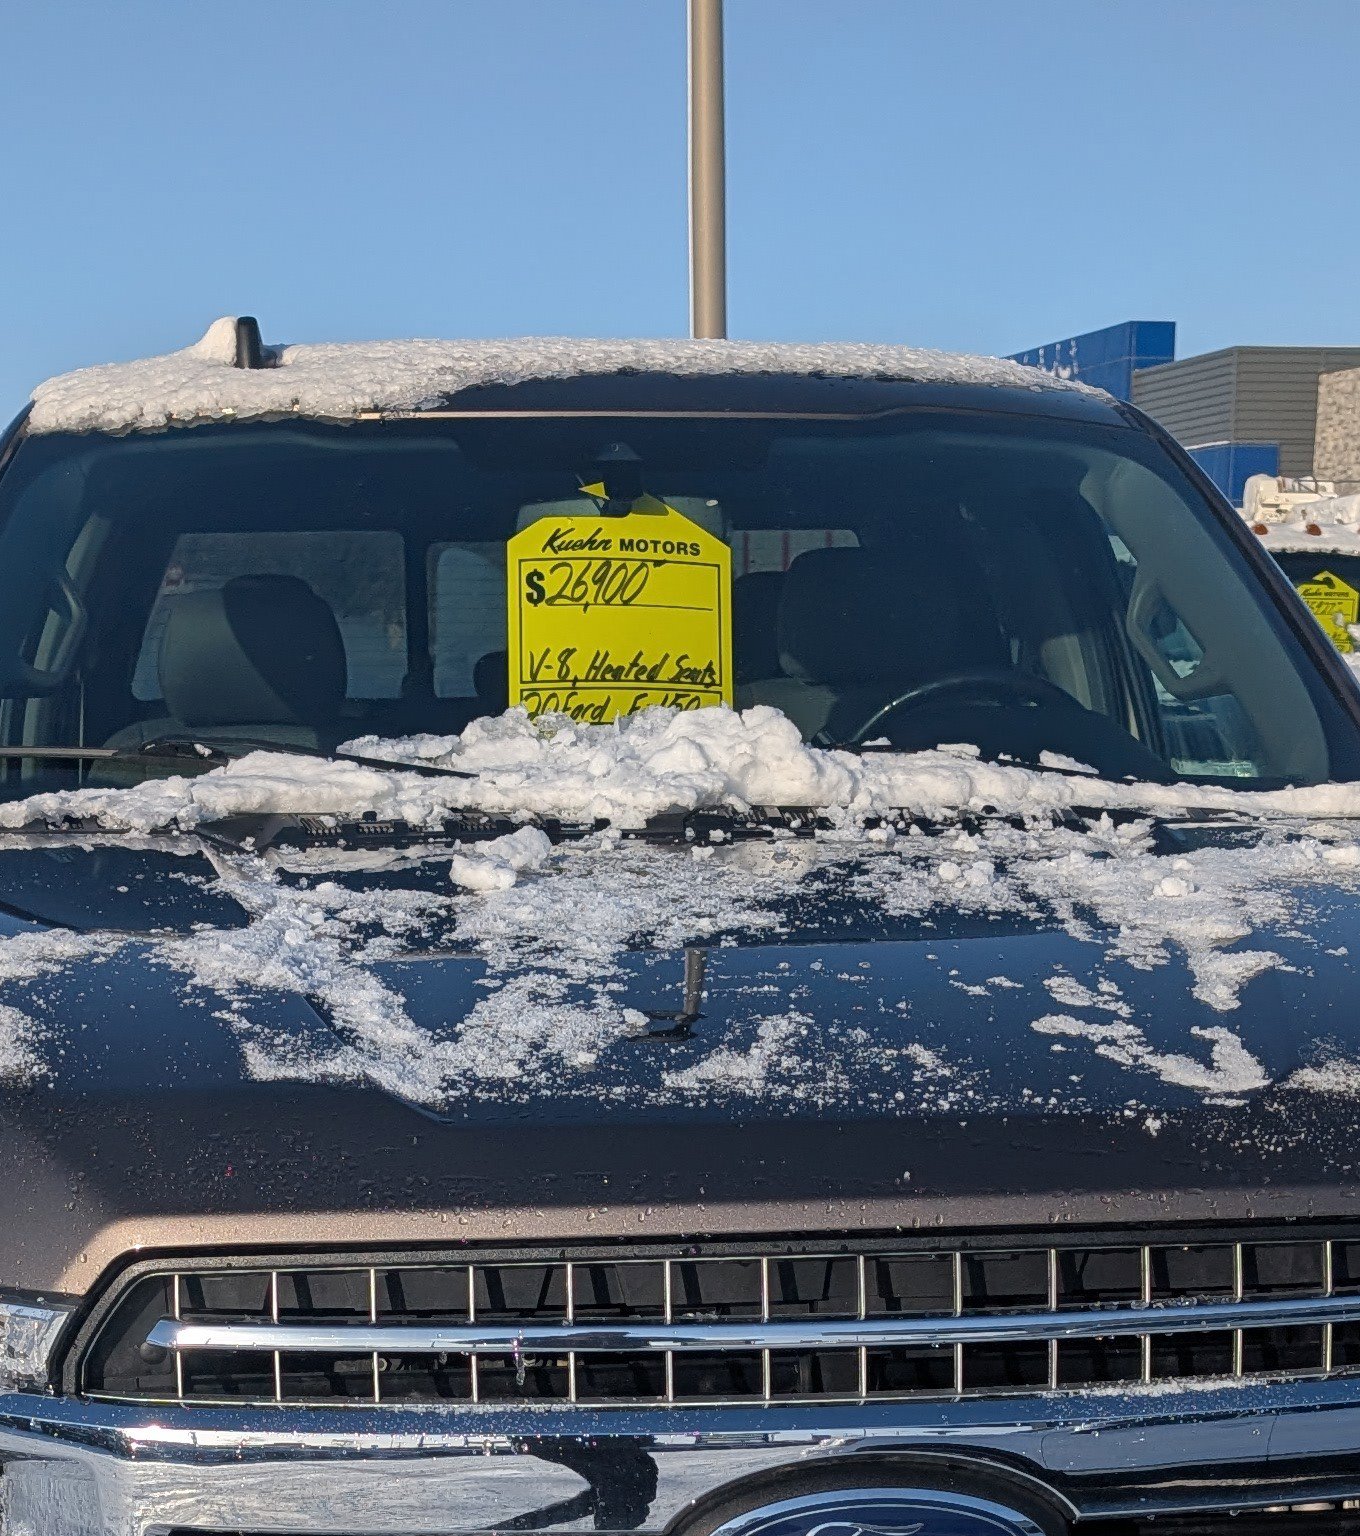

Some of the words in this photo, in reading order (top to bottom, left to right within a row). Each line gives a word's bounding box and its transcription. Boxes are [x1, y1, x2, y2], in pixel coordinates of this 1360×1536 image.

[541, 527, 614, 555] Kuehn
[619, 538, 701, 556] MOTORS
[585, 650, 670, 681] Heated
[668, 653, 717, 688] Seats
